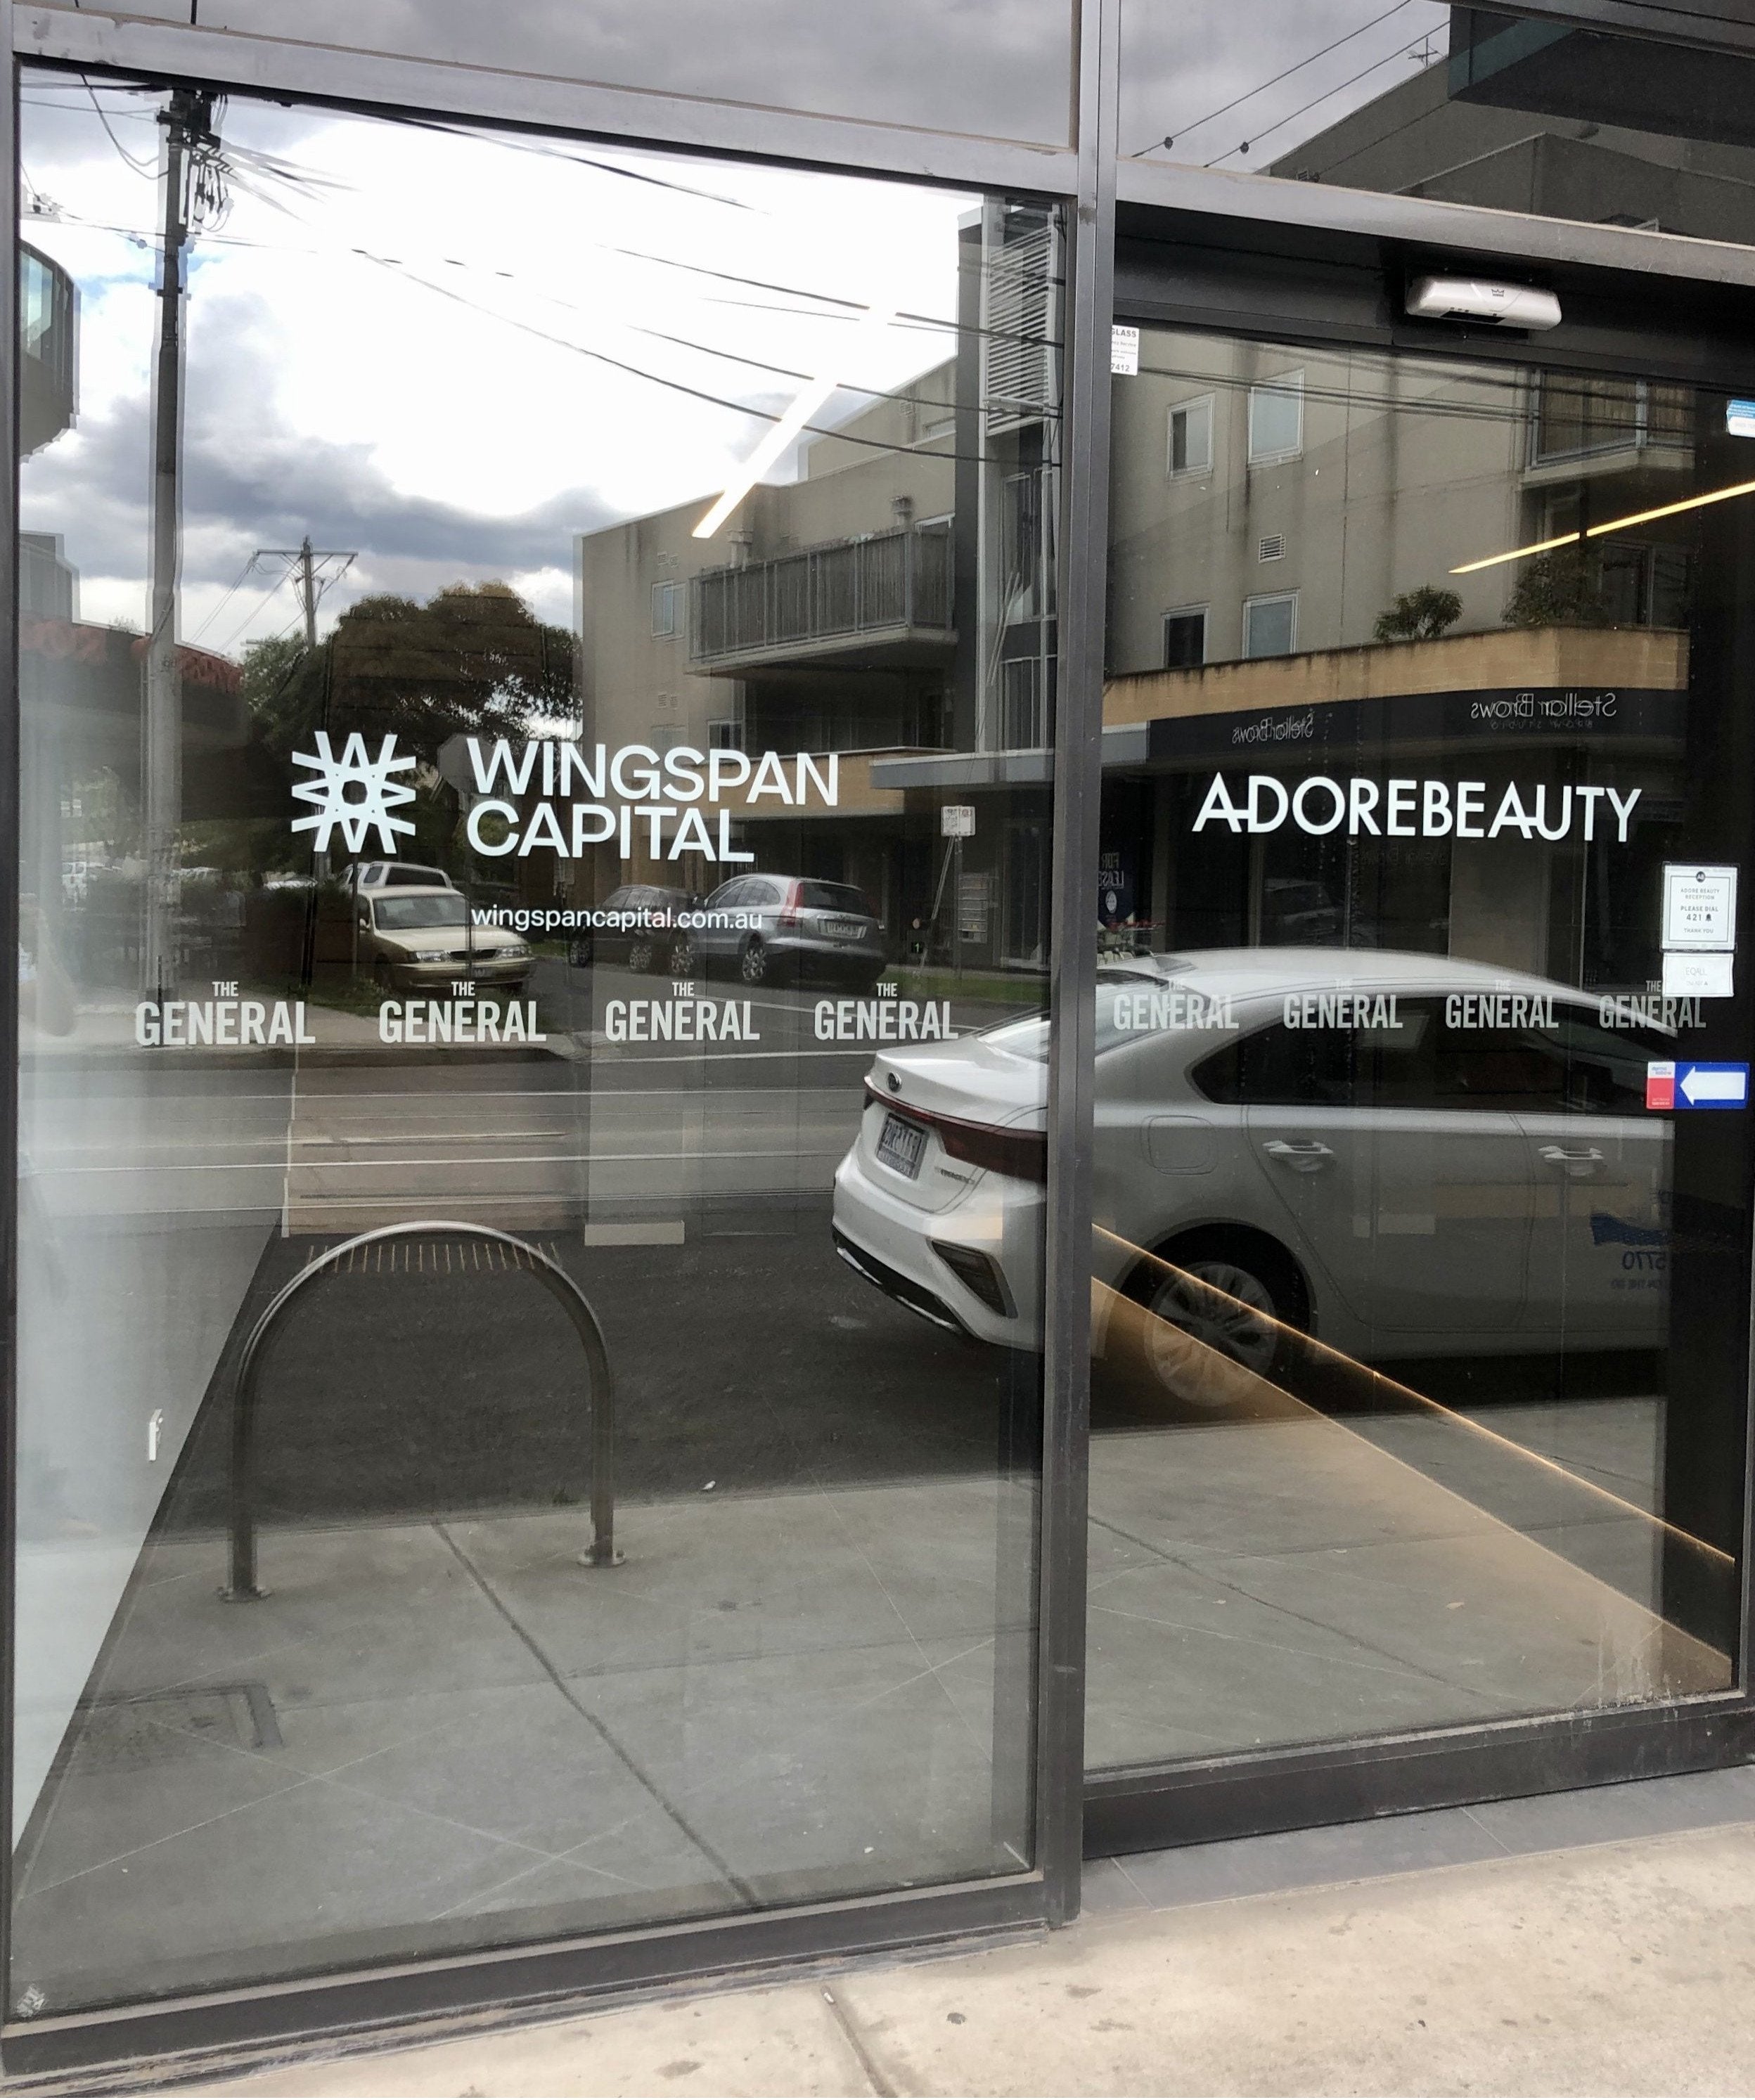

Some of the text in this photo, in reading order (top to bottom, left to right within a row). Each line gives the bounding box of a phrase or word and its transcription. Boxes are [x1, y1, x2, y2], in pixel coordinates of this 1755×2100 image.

[465, 737, 839, 806] WINGSPAN
[1191, 772, 1642, 842] ADOREBEAUTY
[467, 800, 755, 862] CAPITAL
[472, 904, 761, 931] wingspancapital.com.au
[212, 981, 239, 997] THE
[451, 981, 476, 996] THE
[671, 982, 695, 996] THE
[876, 983, 898, 997] THE
[1645, 980, 1662, 992] THE
[135, 1001, 316, 1046] GENERAL
[379, 1000, 547, 1043] GENERAL
[605, 1000, 760, 1041] GENERAL
[814, 1000, 958, 1040] GENERAL
[1113, 993, 1240, 1031] GENERAL
[1282, 993, 1403, 1029] GENERAL
[1446, 994, 1559, 1029] GENERAL
[1599, 994, 1706, 1029] GENERAL
